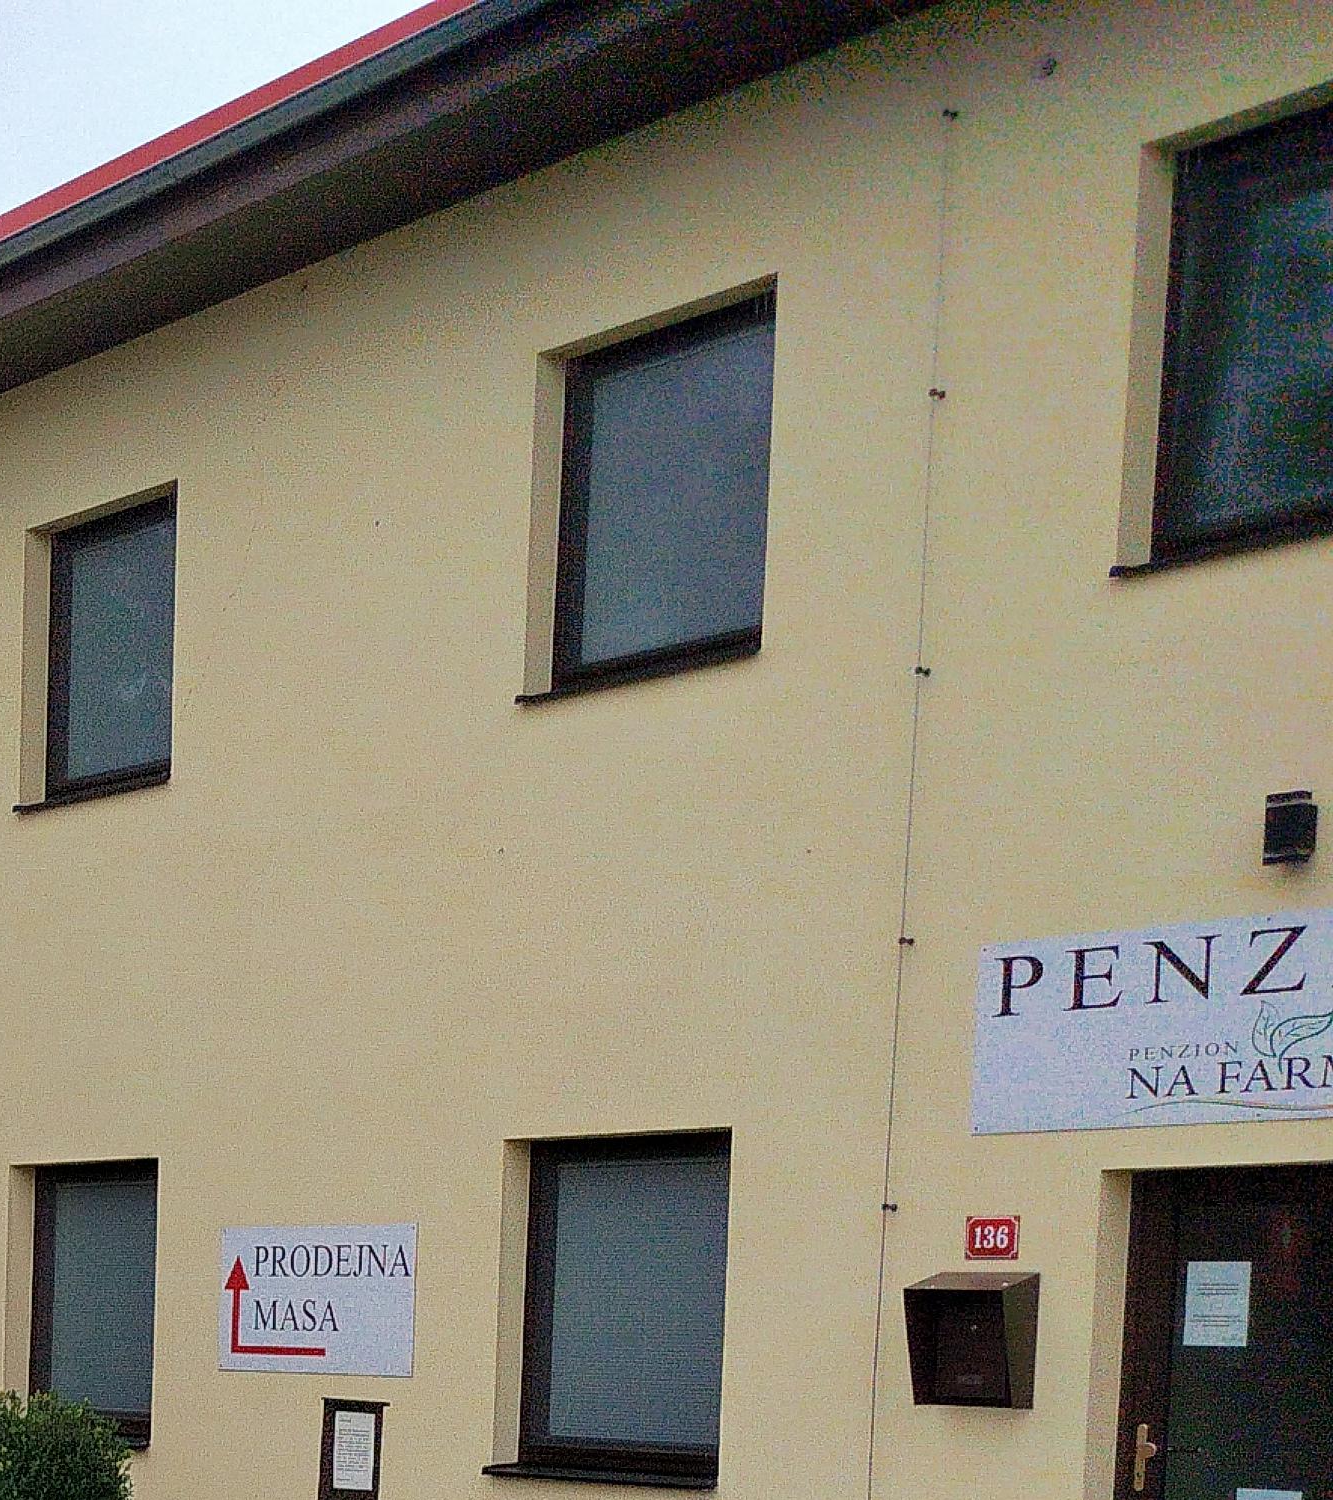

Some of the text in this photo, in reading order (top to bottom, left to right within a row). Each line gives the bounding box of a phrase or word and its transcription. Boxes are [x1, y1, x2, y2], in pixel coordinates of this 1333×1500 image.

[991, 925, 1333, 1019] PENZ
[1128, 1040, 1240, 1062] PENZION
[1126, 1065, 1199, 1100] NA
[973, 1225, 1009, 1250] 136
[253, 1244, 411, 1278] PRODEJNA
[253, 1299, 339, 1332] MASA
